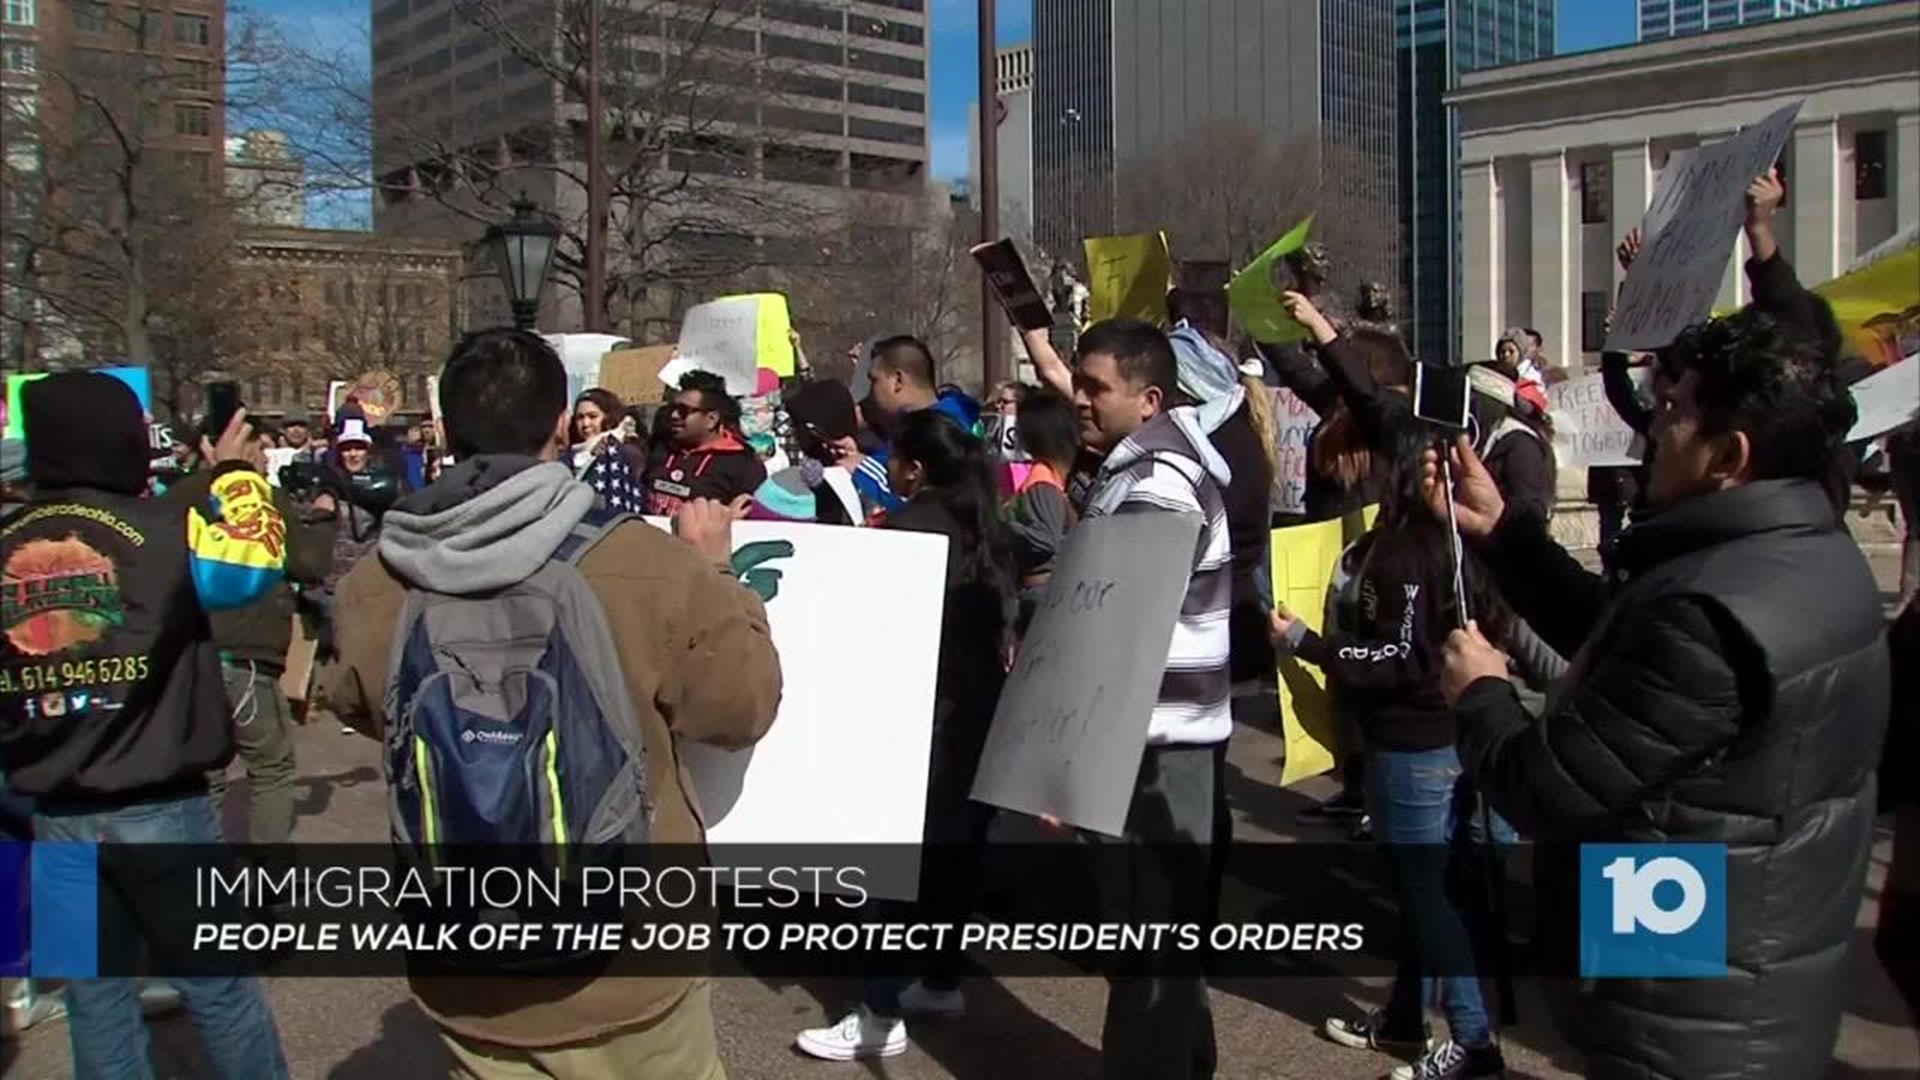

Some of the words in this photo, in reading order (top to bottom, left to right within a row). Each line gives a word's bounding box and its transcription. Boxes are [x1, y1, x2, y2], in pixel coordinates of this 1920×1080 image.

[1557, 384, 1603, 409] KEE
[21, 666, 58, 690] 614
[61, 660, 96, 687] 946
[99, 655, 149, 683] 6285
